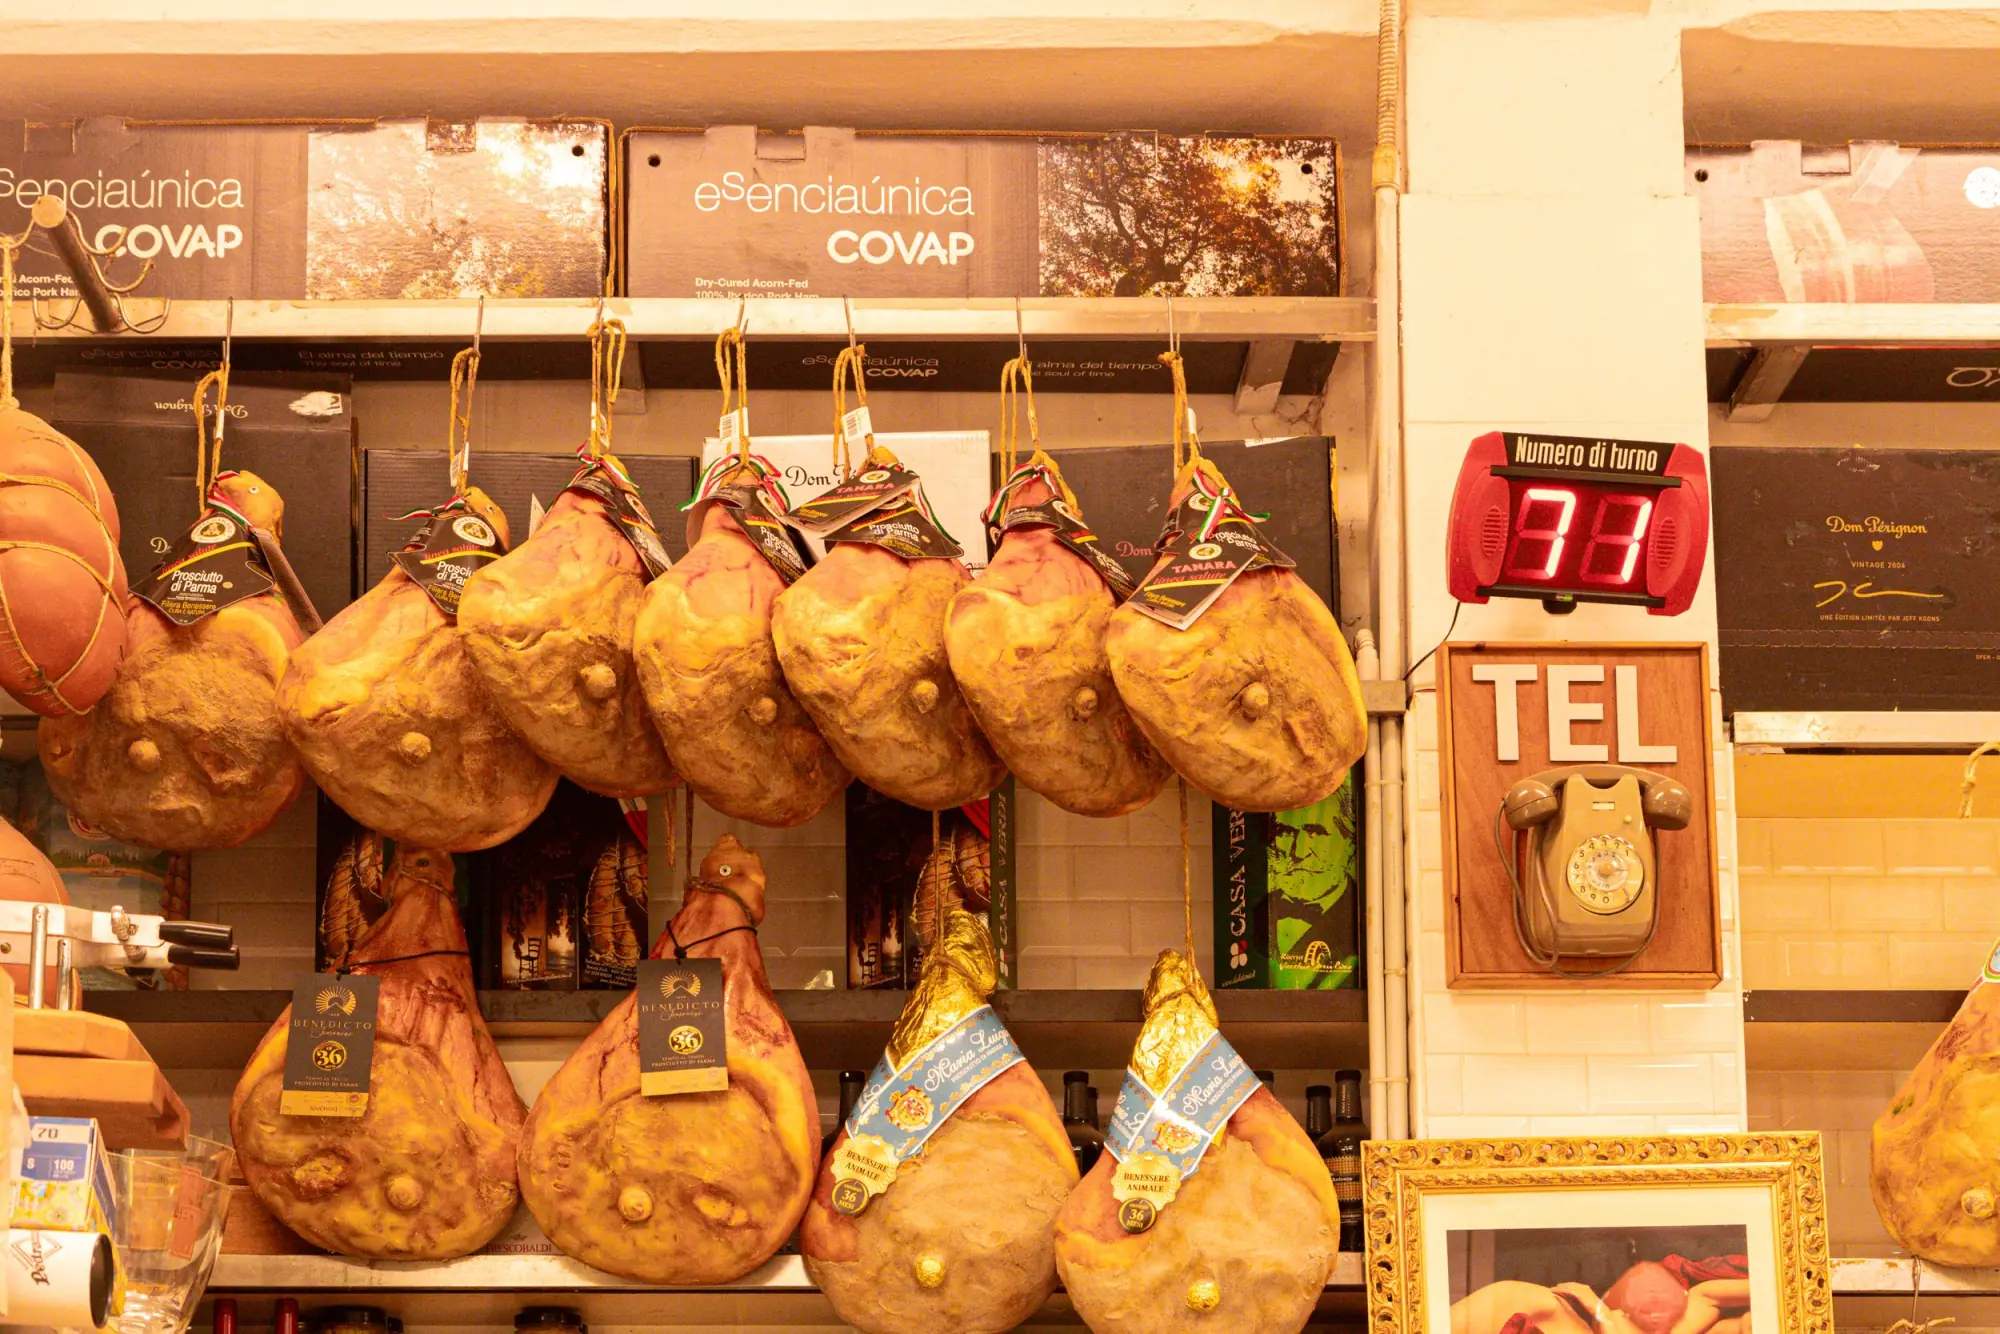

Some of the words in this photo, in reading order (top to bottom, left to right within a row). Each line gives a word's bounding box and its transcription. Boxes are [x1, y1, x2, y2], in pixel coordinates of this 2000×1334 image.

[694, 171, 975, 216] eSenciaúnica
[95, 224, 243, 258] COVAP
[827, 230, 975, 265] COVAP
[695, 277, 750, 289] Dry-Cured
[752, 278, 809, 289] Acorn-Fed
[33, 287, 58, 297] Pork
[360, 350, 385, 360] del
[389, 350, 444, 361] tiempo
[802, 354, 939, 366] eSeciaúnica
[1037, 360, 1075, 369] alma
[1080, 360, 1104, 370] del
[1108, 361, 1162, 372] tiempo
[866, 368, 939, 378] COVAP
[1044, 370, 1070, 378] soul
[1073, 370, 1085, 378] of
[1088, 370, 1116, 378] time
[213, 403, 249, 419] Do
[1515, 436, 1583, 467] Numero
[1588, 442, 1607, 468] di
[1609, 442, 1659, 472] turno
[785, 465, 831, 487] Dom
[1826, 515, 1864, 533] Dom
[1864, 516, 1928, 539] Pérignon
[1115, 540, 1154, 557] Dom
[1171, 559, 1237, 574] TANARA
[1851, 561, 1885, 569] VINTAGE
[171, 570, 224, 583] Prosciutto
[436, 571, 448, 581] di
[1188, 571, 1228, 582] salute
[170, 580, 183, 592] di
[183, 580, 217, 594] Parma
[1834, 612, 1861, 621] ÉDITION
[1861, 613, 1886, 622] LIMITÉE
[1472, 664, 1678, 763] TEL
[1230, 809, 1246, 863] VER
[1230, 864, 1247, 937] CASA
[643, 1001, 720, 1013] BENEDICTO
[293, 1019, 372, 1031] BENEDICTO
[673, 1034, 700, 1051] 36
[317, 1048, 342, 1067] 36
[924, 1050, 976, 1092] Maria
[1182, 1075, 1224, 1116] Maria
[37, 1127, 59, 1139] 70
[54, 1159, 74, 1171] 100
[846, 1150, 889, 1173] BENESSERE
[845, 1162, 881, 1182] ANIMALE
[1123, 1172, 1171, 1183] BENESSERE
[1126, 1183, 1164, 1193] ANIMALE
[841, 1189, 857, 1203] 36
[1128, 1208, 1145, 1221] 36
[1126, 1219, 1145, 1228] MESI
